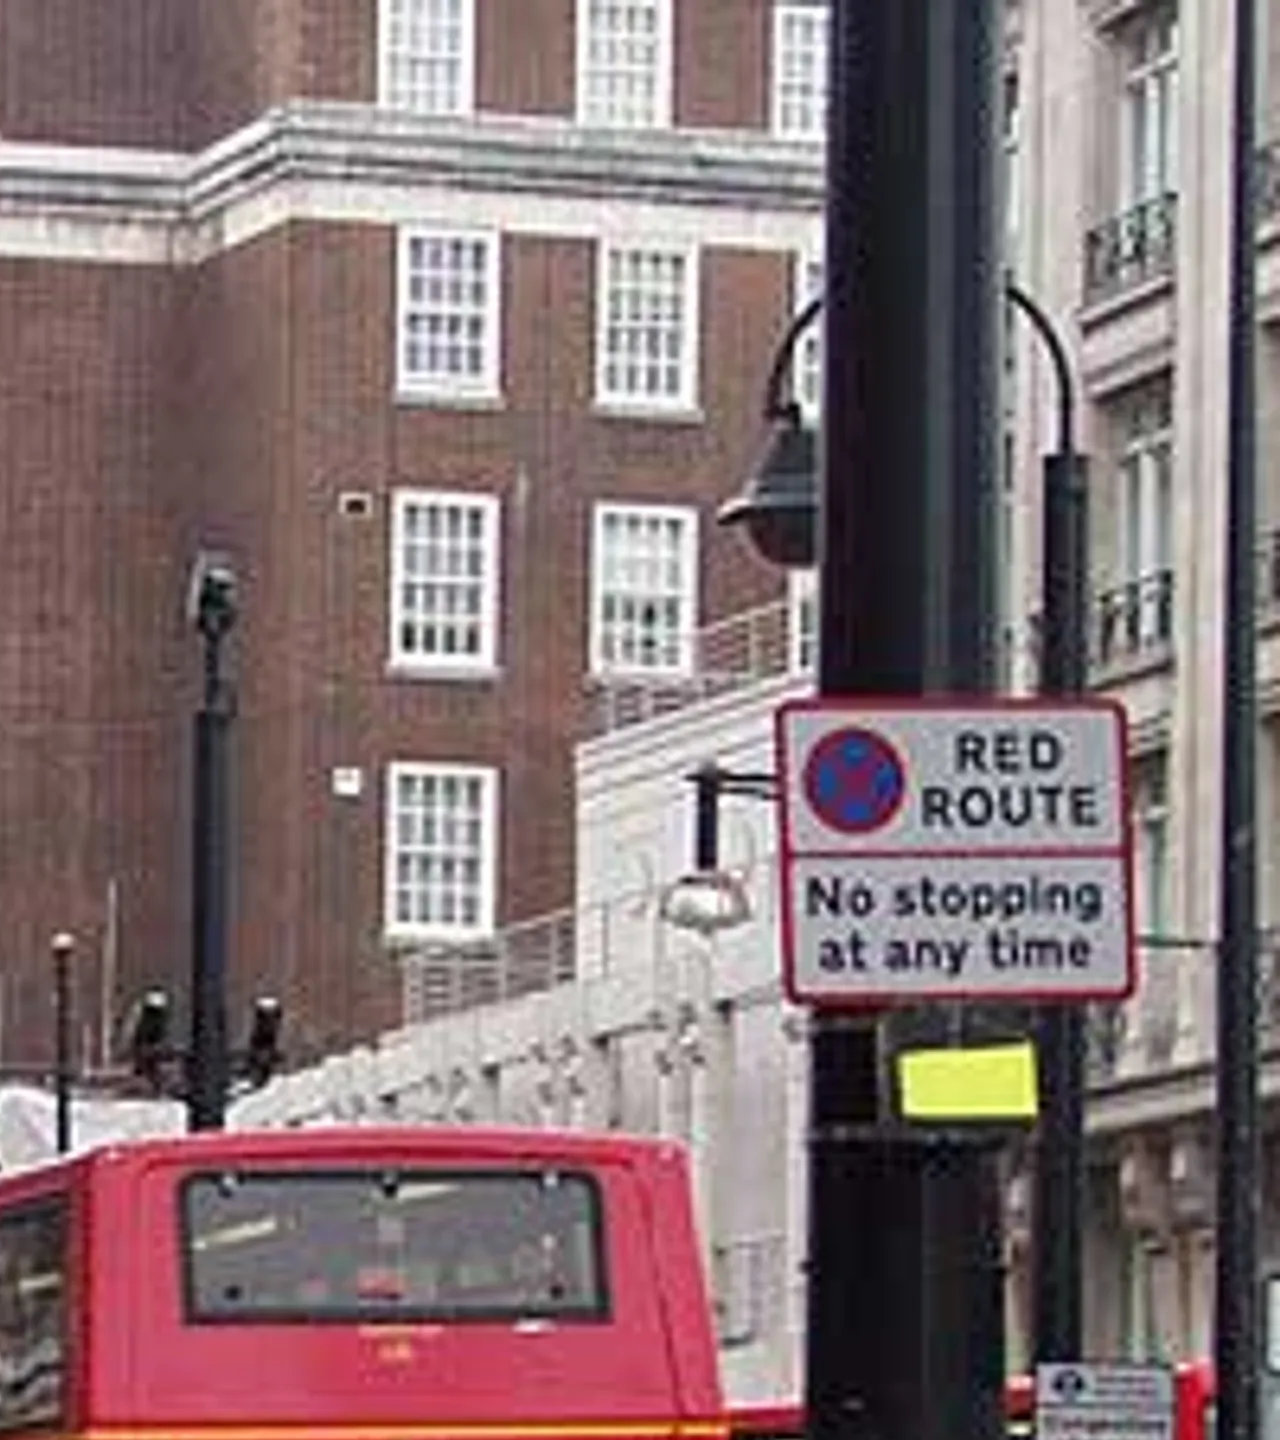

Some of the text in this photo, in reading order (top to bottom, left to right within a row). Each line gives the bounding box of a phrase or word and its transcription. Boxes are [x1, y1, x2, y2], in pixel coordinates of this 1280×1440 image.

[956, 731, 1062, 774] RED
[921, 786, 1097, 827] ROUTE
[805, 876, 1103, 923] No stopping
[819, 935, 1091, 975] at any time
